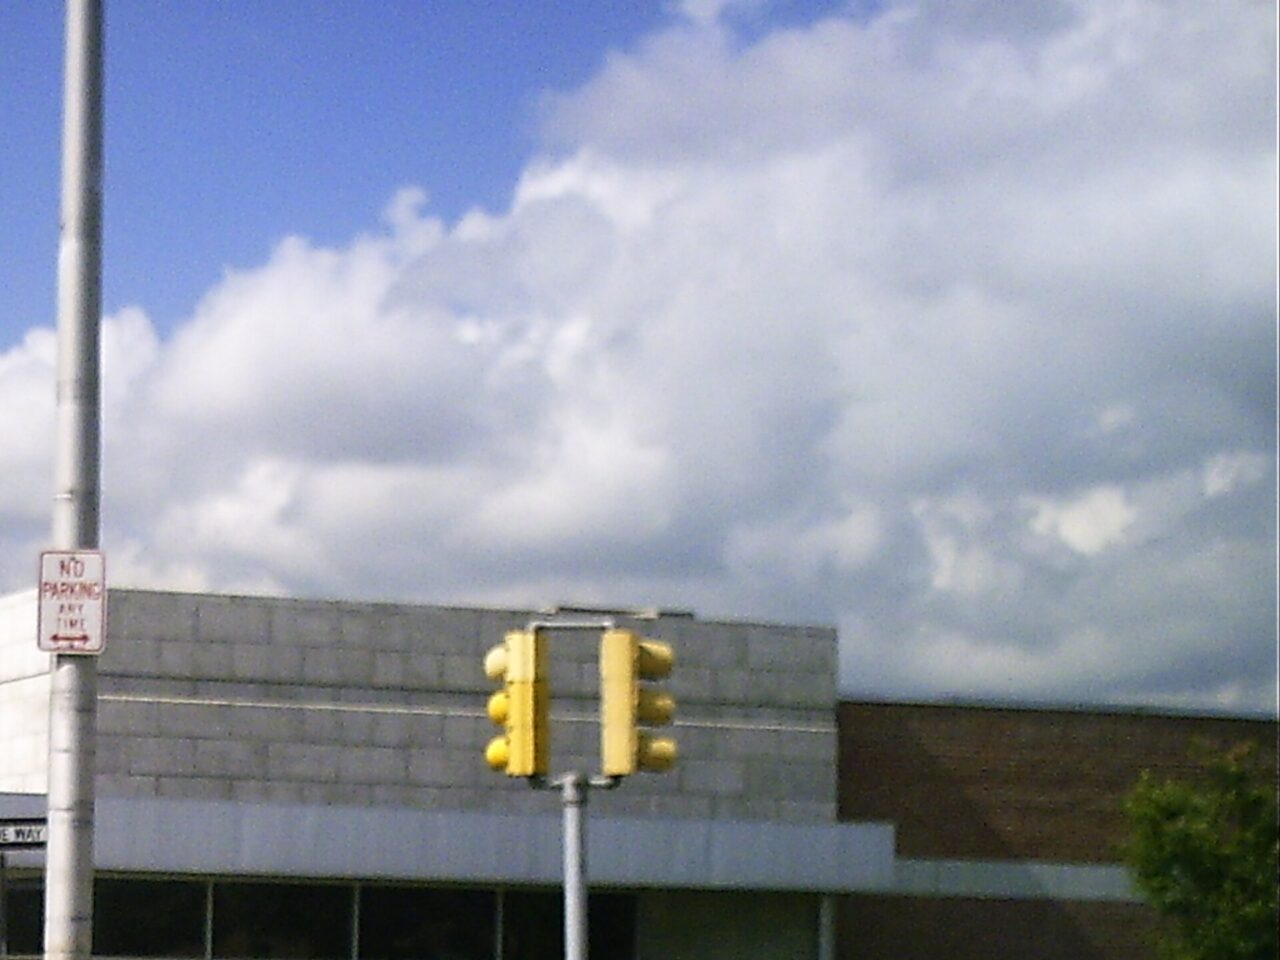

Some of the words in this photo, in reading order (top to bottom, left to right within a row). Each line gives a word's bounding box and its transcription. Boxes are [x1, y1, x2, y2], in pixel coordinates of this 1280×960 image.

[60, 560, 85, 578] NO
[43, 582, 101, 600] PARKING
[14, 828, 44, 841] WAY
